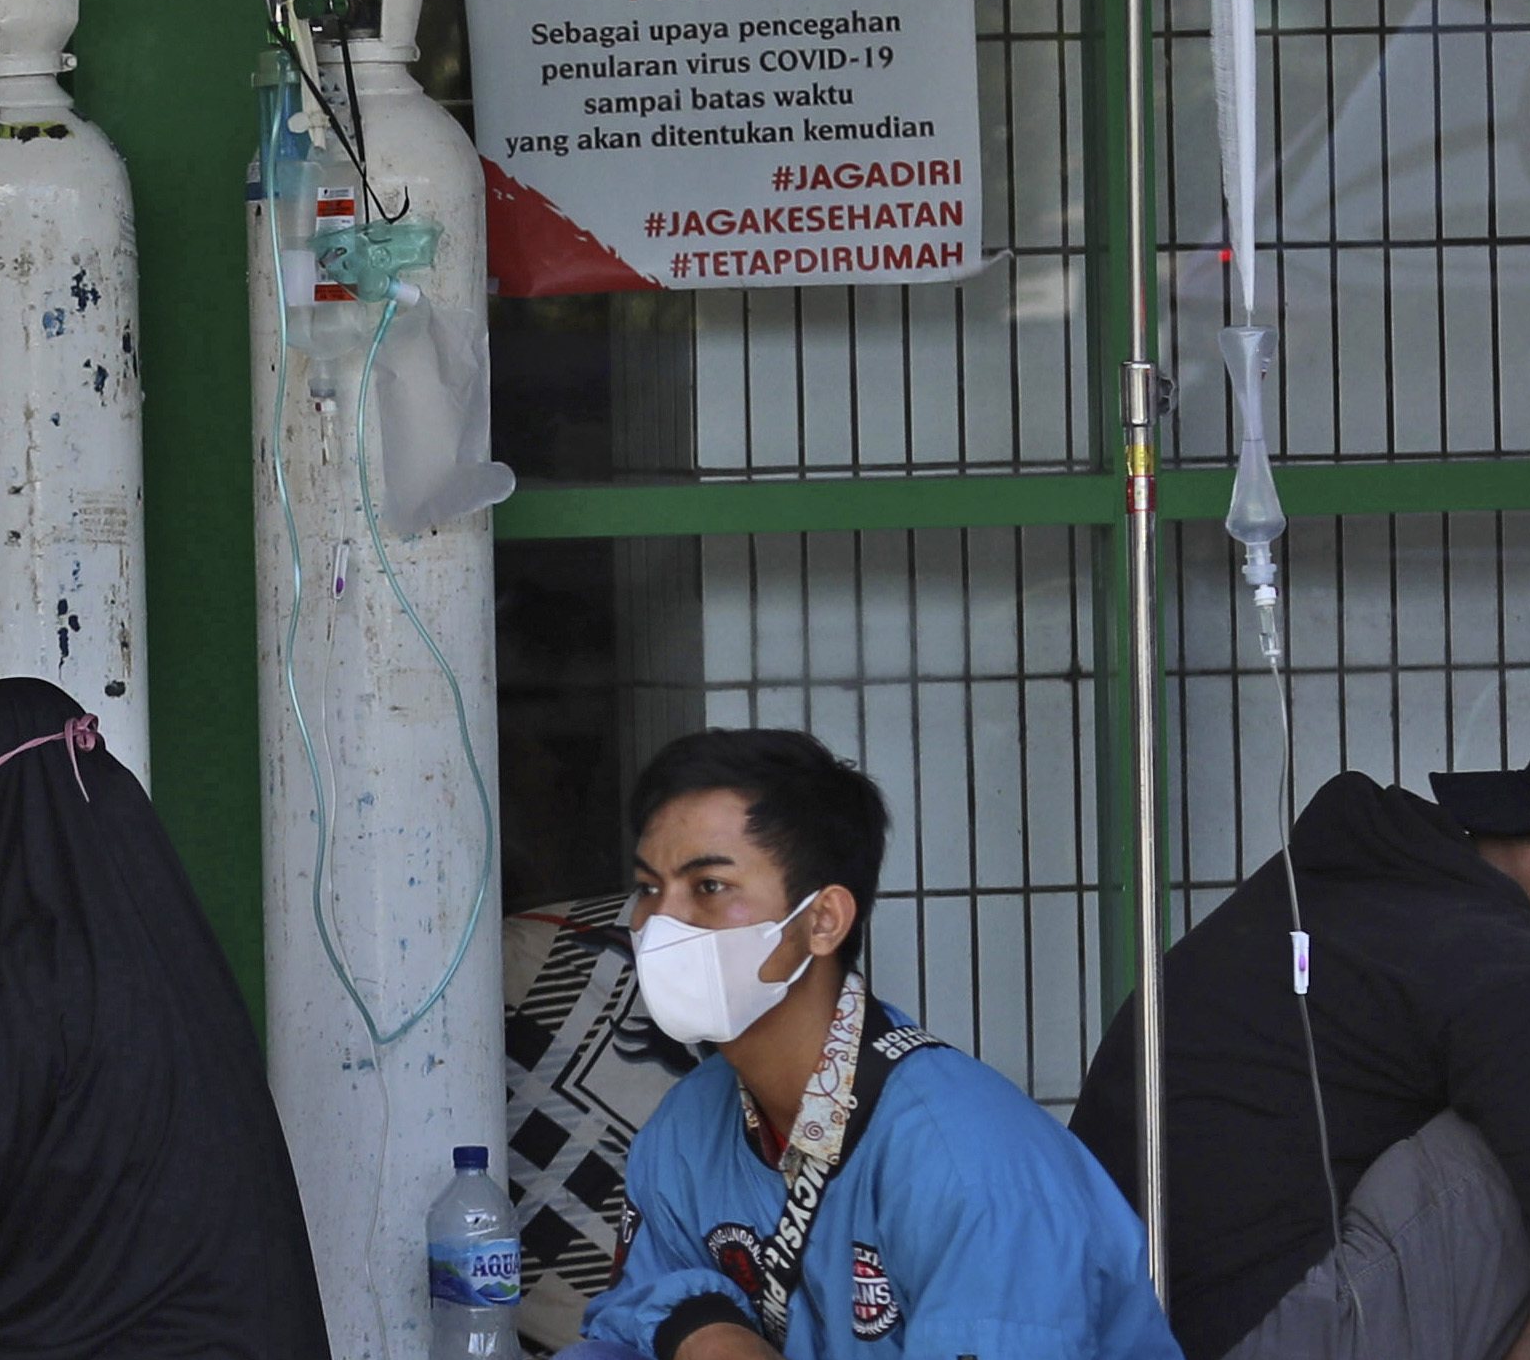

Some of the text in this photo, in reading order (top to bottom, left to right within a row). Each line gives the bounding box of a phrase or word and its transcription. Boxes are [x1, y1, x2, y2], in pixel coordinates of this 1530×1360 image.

[531, 9, 901, 49] Sebagai upaya pencegahan
[541, 45, 894, 86] penularan virus COVID-19
[584, 82, 854, 118] sampai batas waktu
[504, 115, 935, 160] yang akan ditentukan kemudian
[772, 160, 962, 191] #JAGADIRI
[645, 202, 963, 237] #JAGAKESEHATAN
[670, 243, 963, 278] #TETAPDIRUMAH
